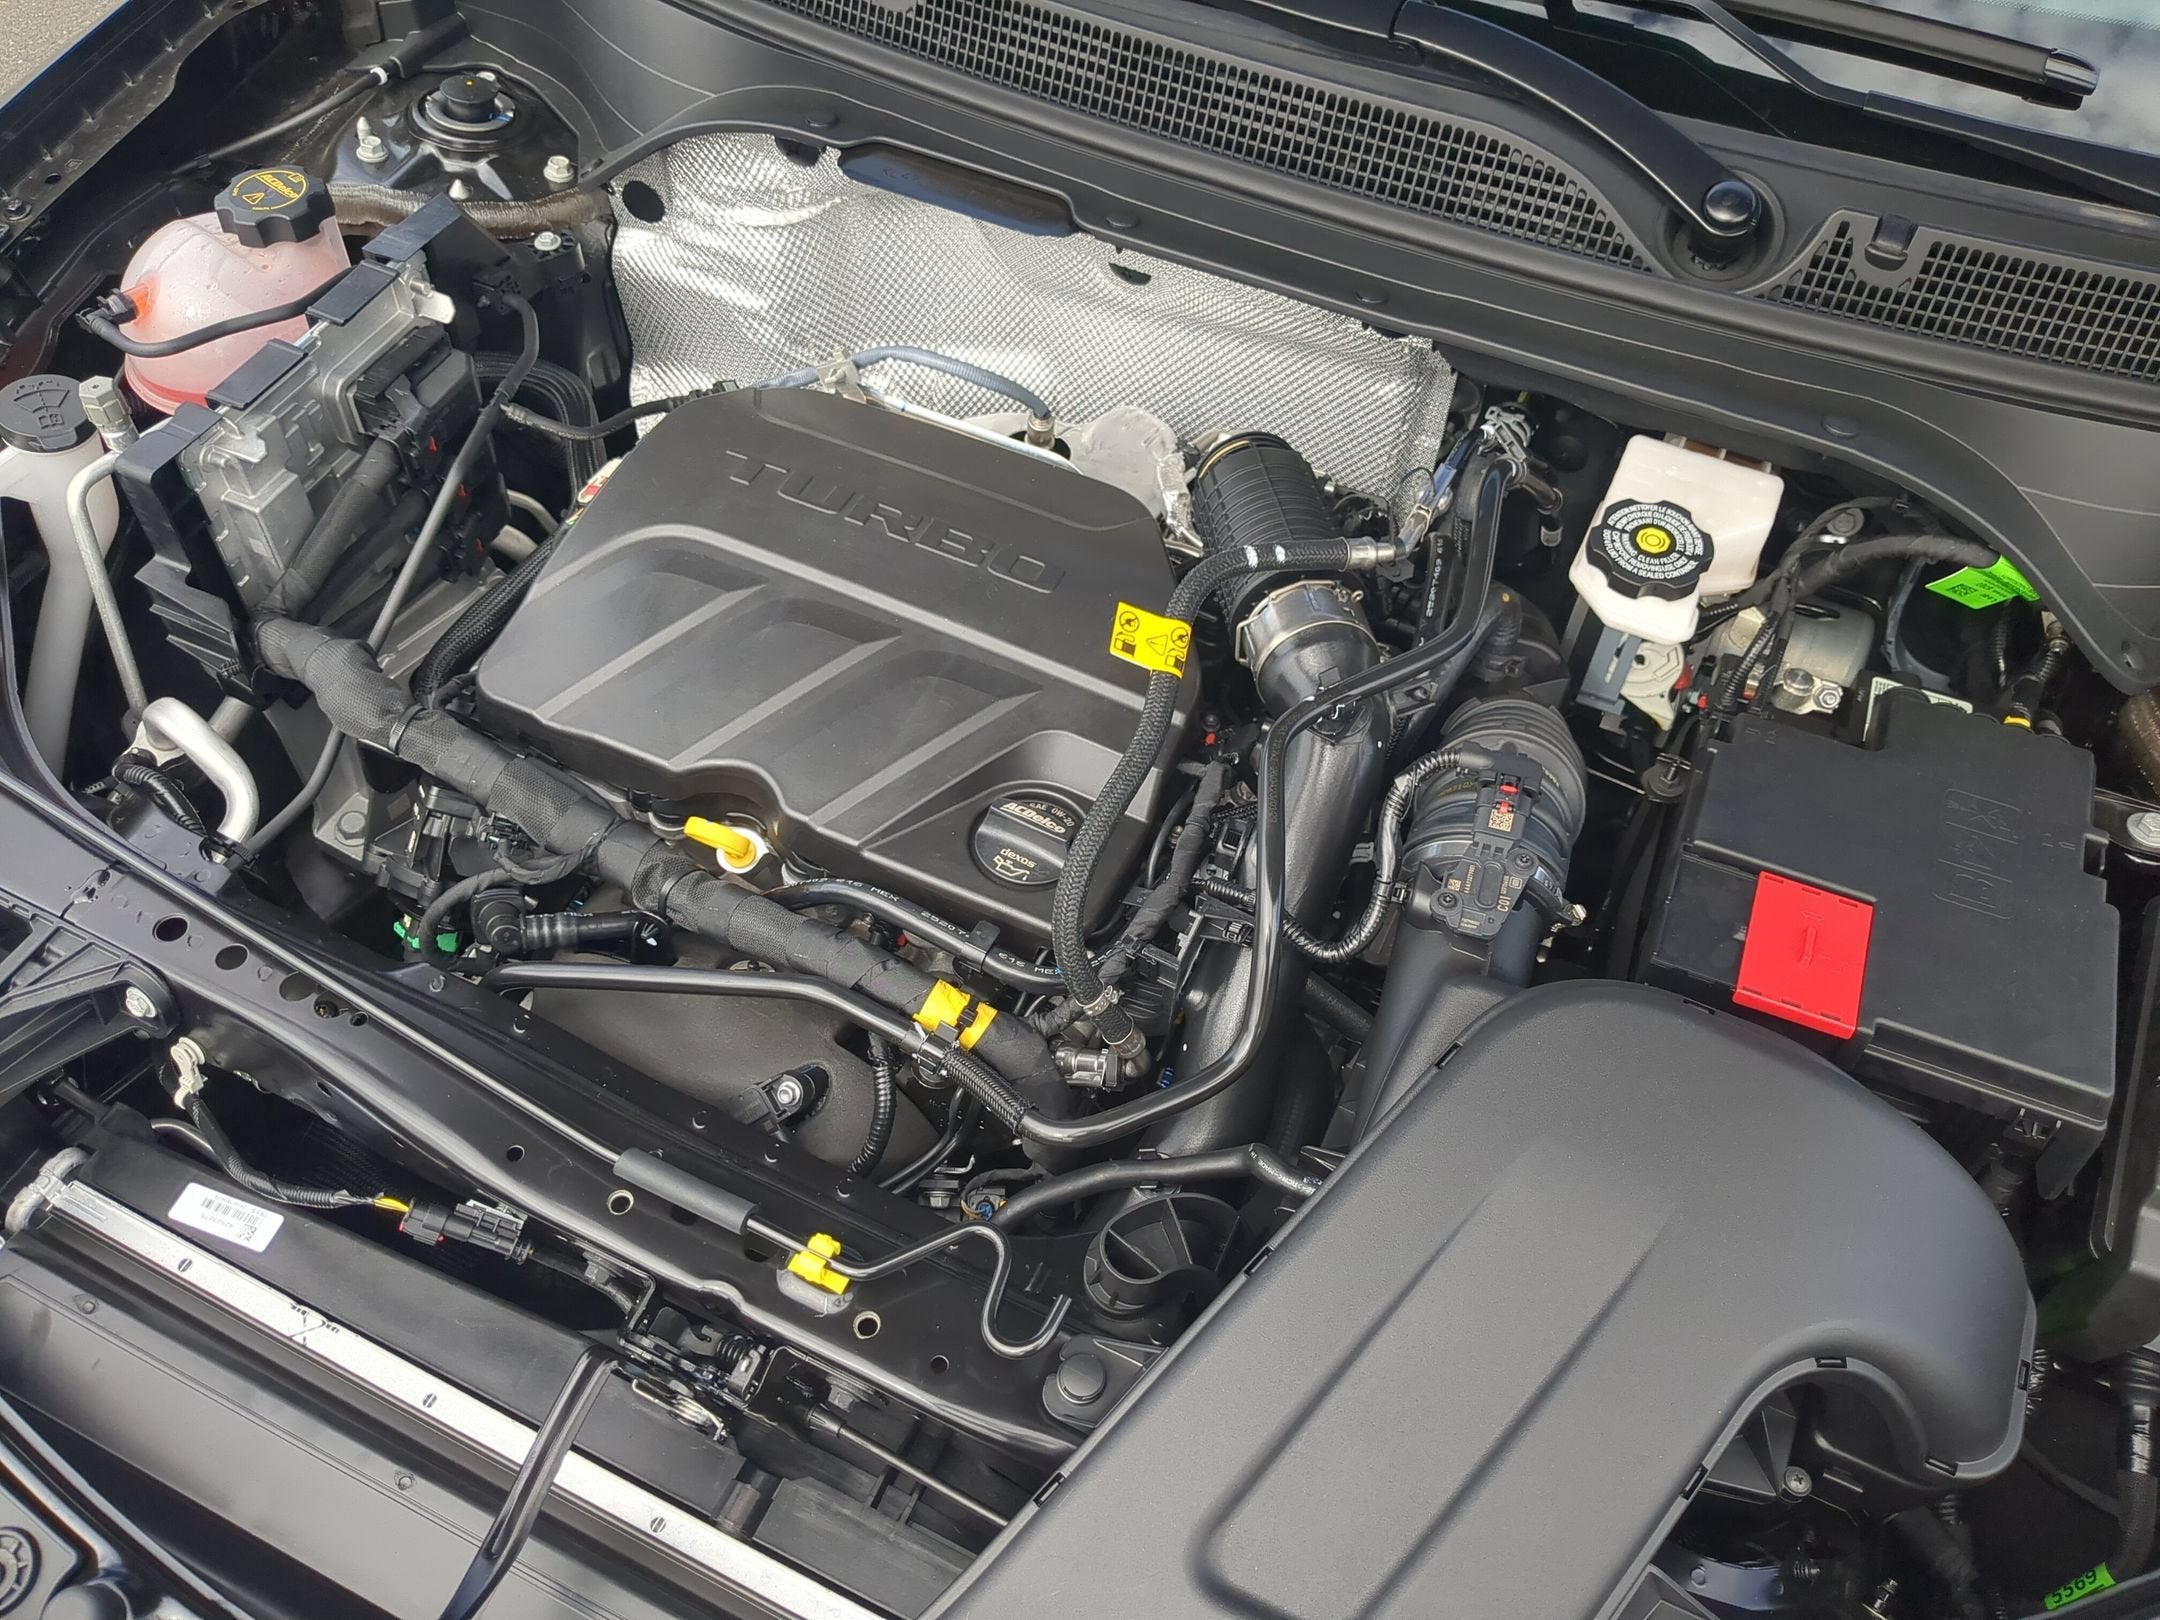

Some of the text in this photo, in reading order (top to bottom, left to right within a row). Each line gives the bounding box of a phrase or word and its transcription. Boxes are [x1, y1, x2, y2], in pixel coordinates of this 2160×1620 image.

[726, 449, 1066, 594] TURBO
[1637, 554, 1660, 565] CLEAN
[1660, 551, 1681, 565] FILLER
[1638, 568, 1664, 579] SEALED
[1664, 559, 1700, 579] CONTAINER
[1000, 802, 1066, 834] ACDelco
[1051, 807, 1075, 828] 0W-20
[1000, 848, 1038, 868] dexos
[870, 886, 900, 901] MEX
[998, 952, 1026, 967] 616
[2052, 1568, 2097, 1604] 5569
